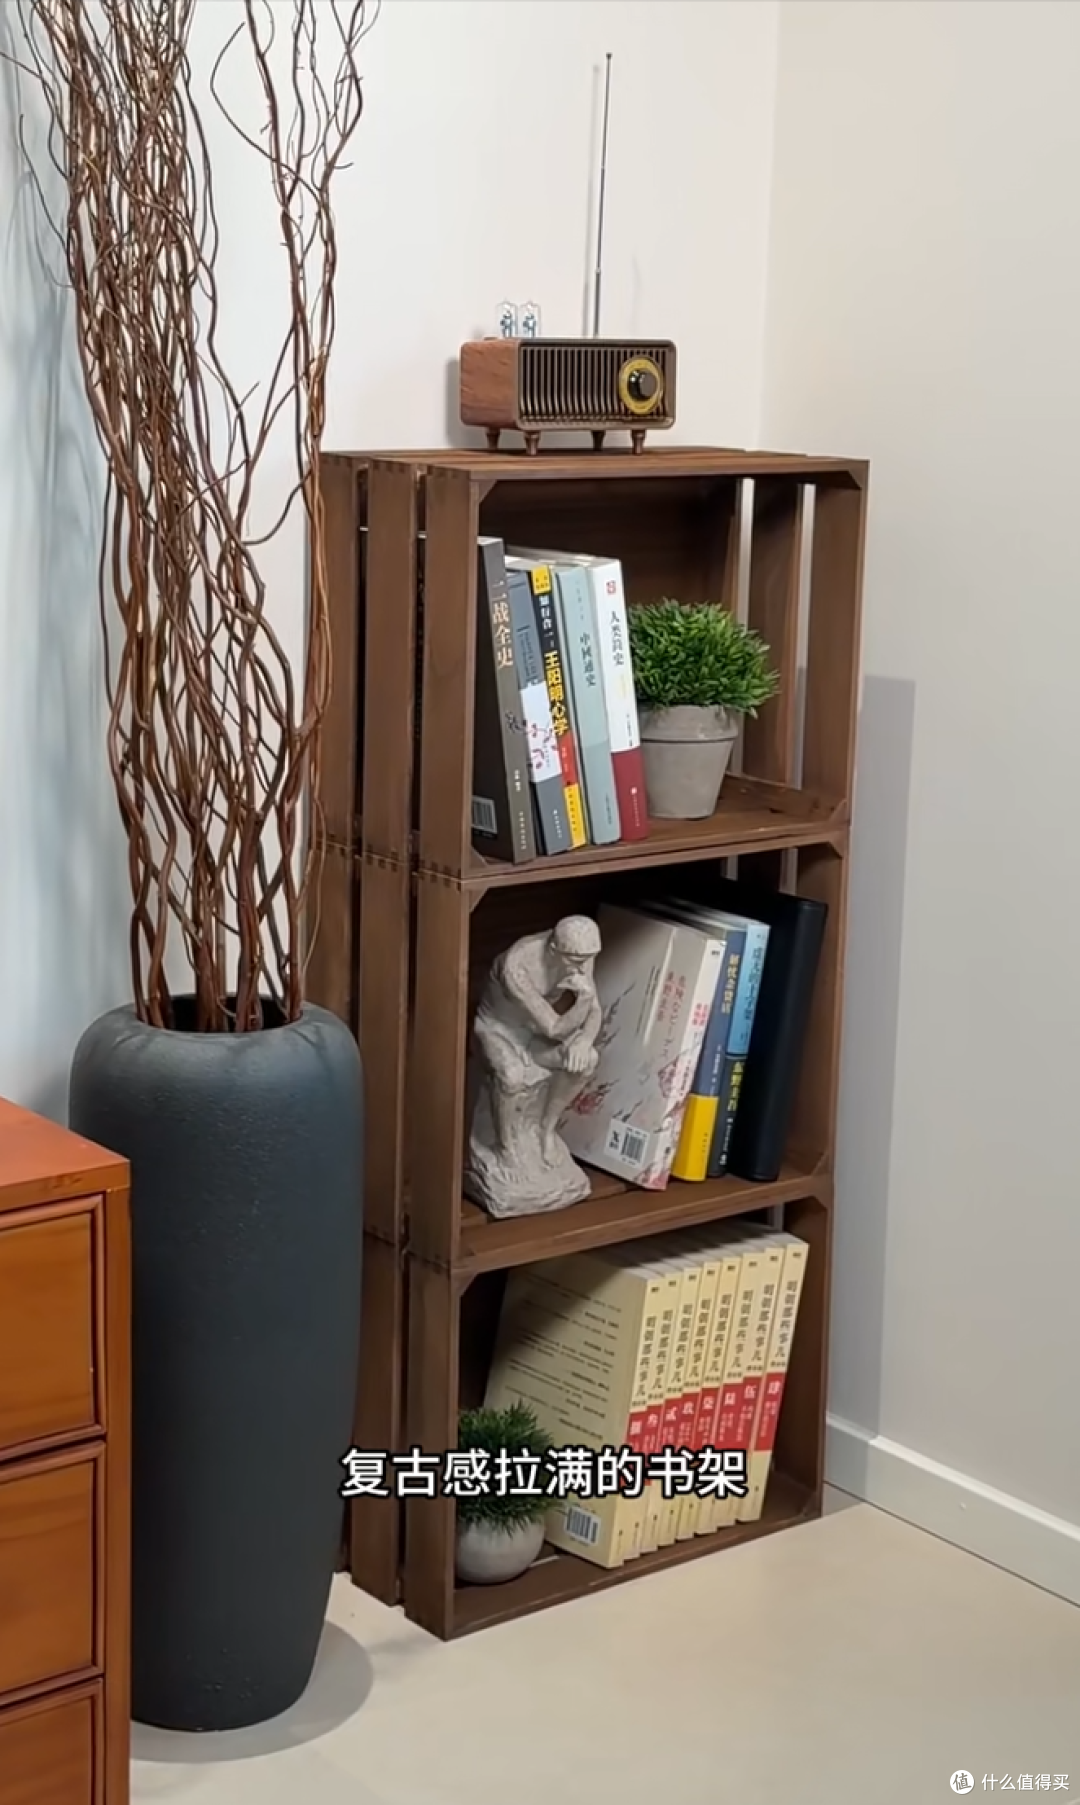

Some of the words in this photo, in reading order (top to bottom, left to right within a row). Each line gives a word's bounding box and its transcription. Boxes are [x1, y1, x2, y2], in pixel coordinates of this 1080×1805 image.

[492, 580, 514, 668] 二战全史
[580, 632, 597, 687] 中国通史
[610, 610, 625, 667] 人类简史
[544, 650, 569, 735] 王阳明心学
[636, 1316, 657, 1396] 明朝那些事儿
[652, 1309, 674, 1389] 明朝那些事儿
[671, 1304, 693, 1383] 明朝那些事儿
[688, 1298, 712, 1378] 明朝那些事儿
[709, 1294, 732, 1372] 明朝那些事儿
[731, 1290, 754, 1368] 明朝那些事儿
[751, 1284, 775, 1361] 明朝那些事儿
[775, 1281, 798, 1358] 明朝那些事儿
